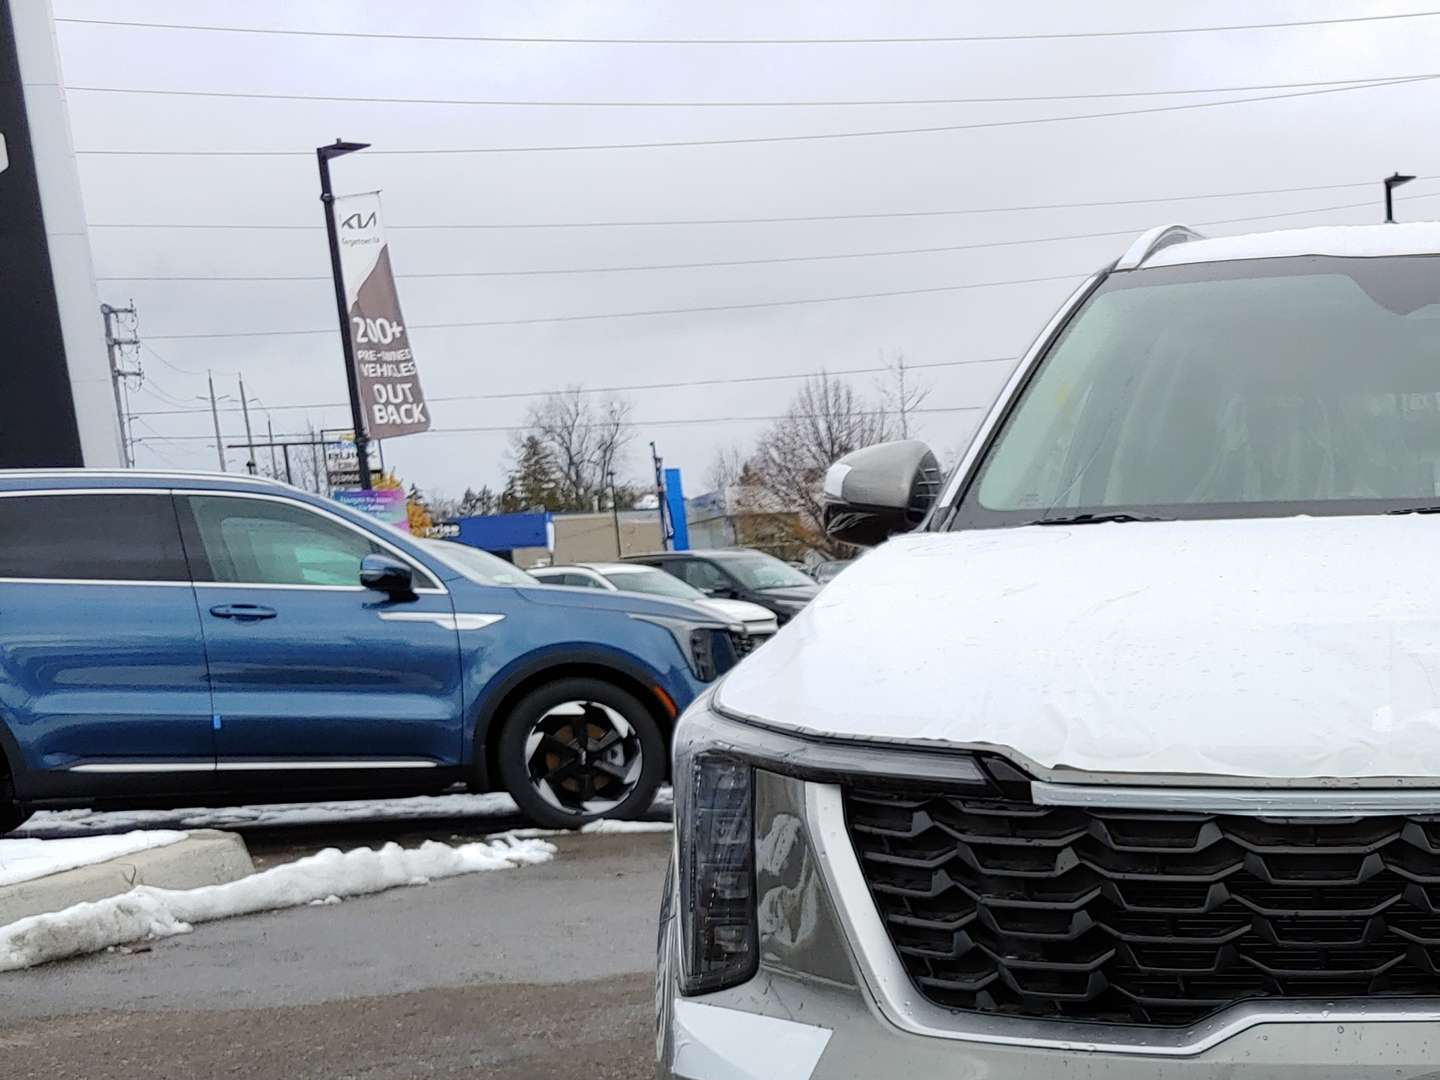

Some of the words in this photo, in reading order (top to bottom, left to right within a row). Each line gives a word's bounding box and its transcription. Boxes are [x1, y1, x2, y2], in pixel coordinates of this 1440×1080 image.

[352, 316, 403, 345] 200+
[360, 361, 417, 378] VEHICLES
[373, 382, 414, 403] OUT
[372, 402, 427, 425] BACK
